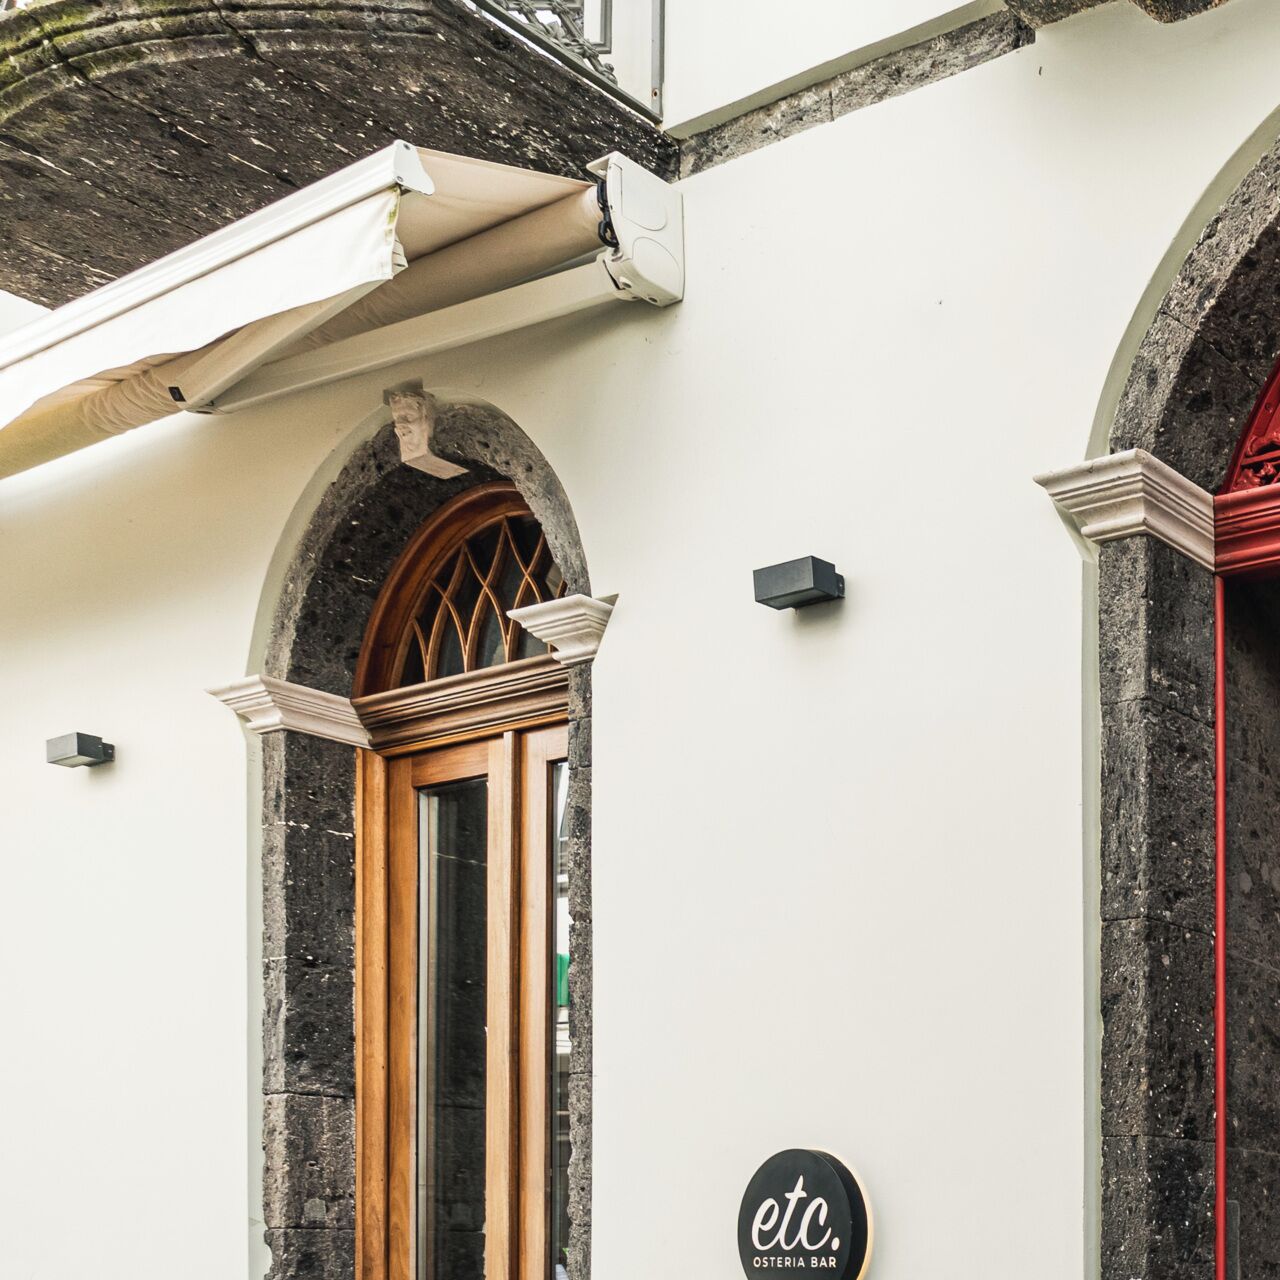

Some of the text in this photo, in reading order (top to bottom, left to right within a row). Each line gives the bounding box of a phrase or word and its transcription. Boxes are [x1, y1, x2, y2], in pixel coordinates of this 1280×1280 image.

[752, 1175, 840, 1250] etc.
[753, 1256, 837, 1268] OSTERIA BAR
